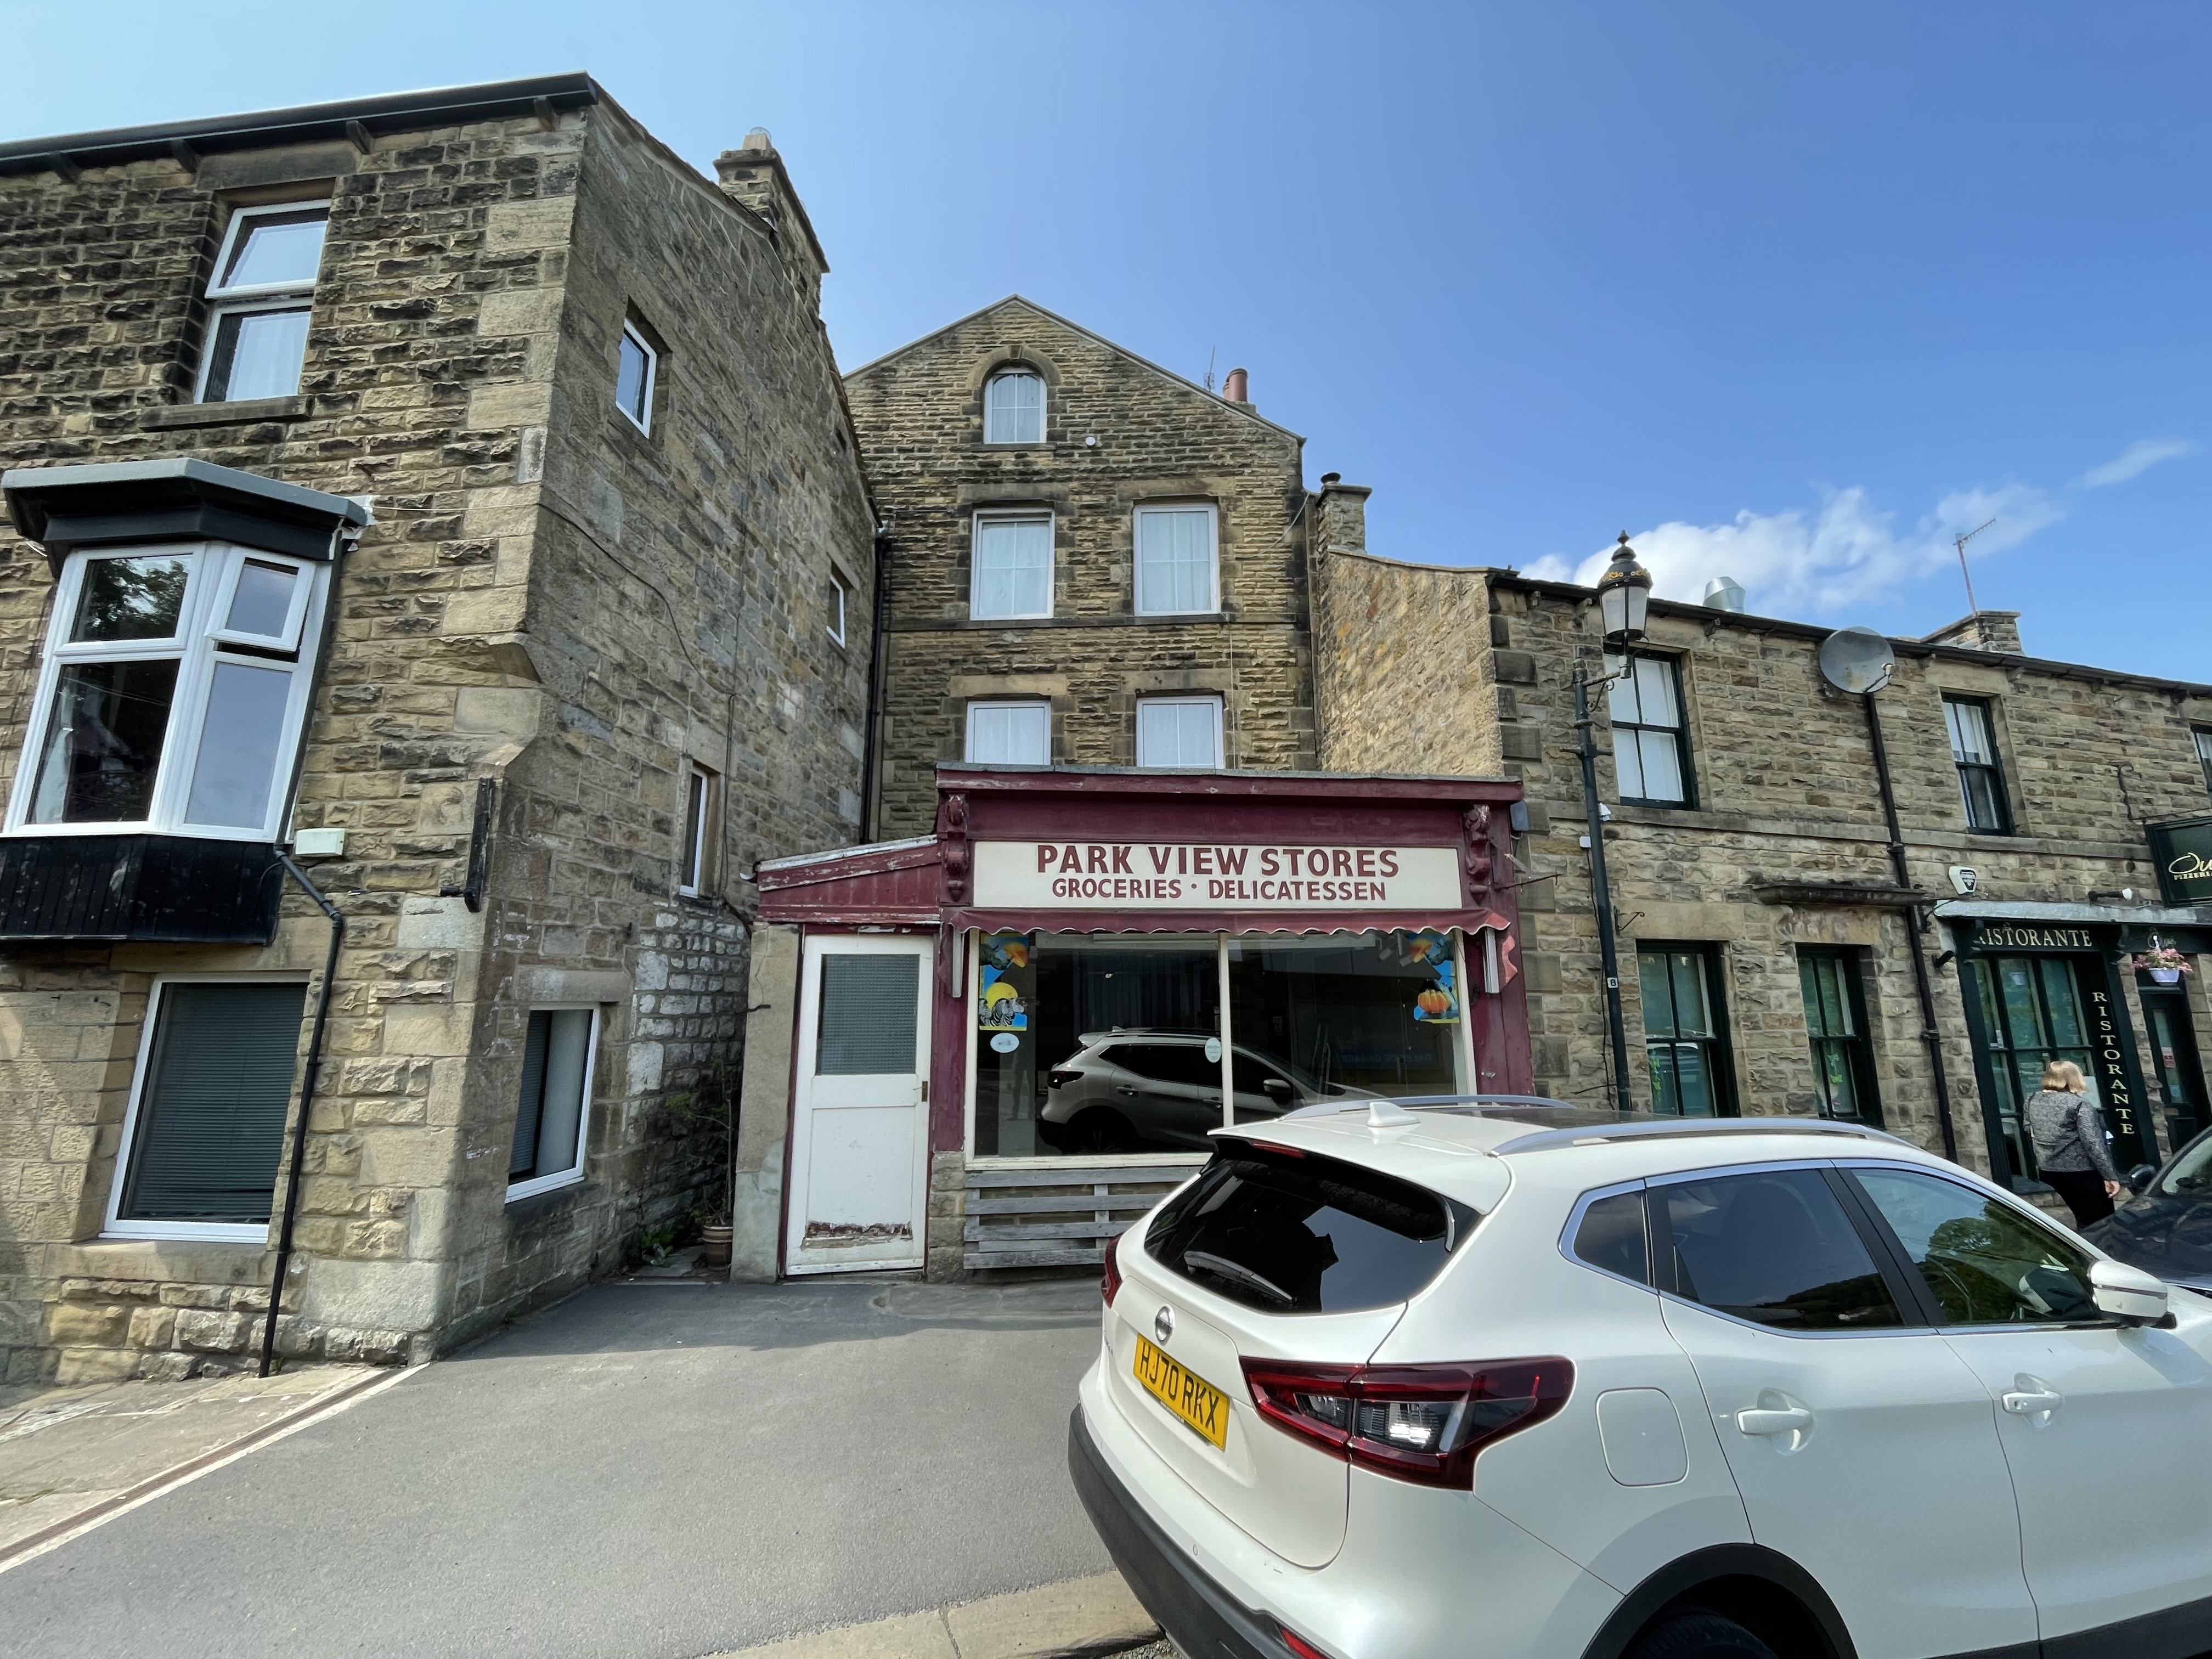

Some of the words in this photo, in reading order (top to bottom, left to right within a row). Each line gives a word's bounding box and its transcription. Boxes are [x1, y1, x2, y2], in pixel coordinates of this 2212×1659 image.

[1037, 845, 1134, 874] PARK
[1148, 847, 1249, 876] VIEW
[1261, 848, 1400, 878] STORES
[2174, 871, 2212, 880] PIZZERI
[1052, 878, 1182, 899] GROCERIES
[1208, 879, 1386, 901] DELICATESSEN
[2092, 992, 2135, 1135] RISTORANTE
[1140, 1342, 1179, 1401] HJ70
[1182, 1374, 1219, 1434] RKX
